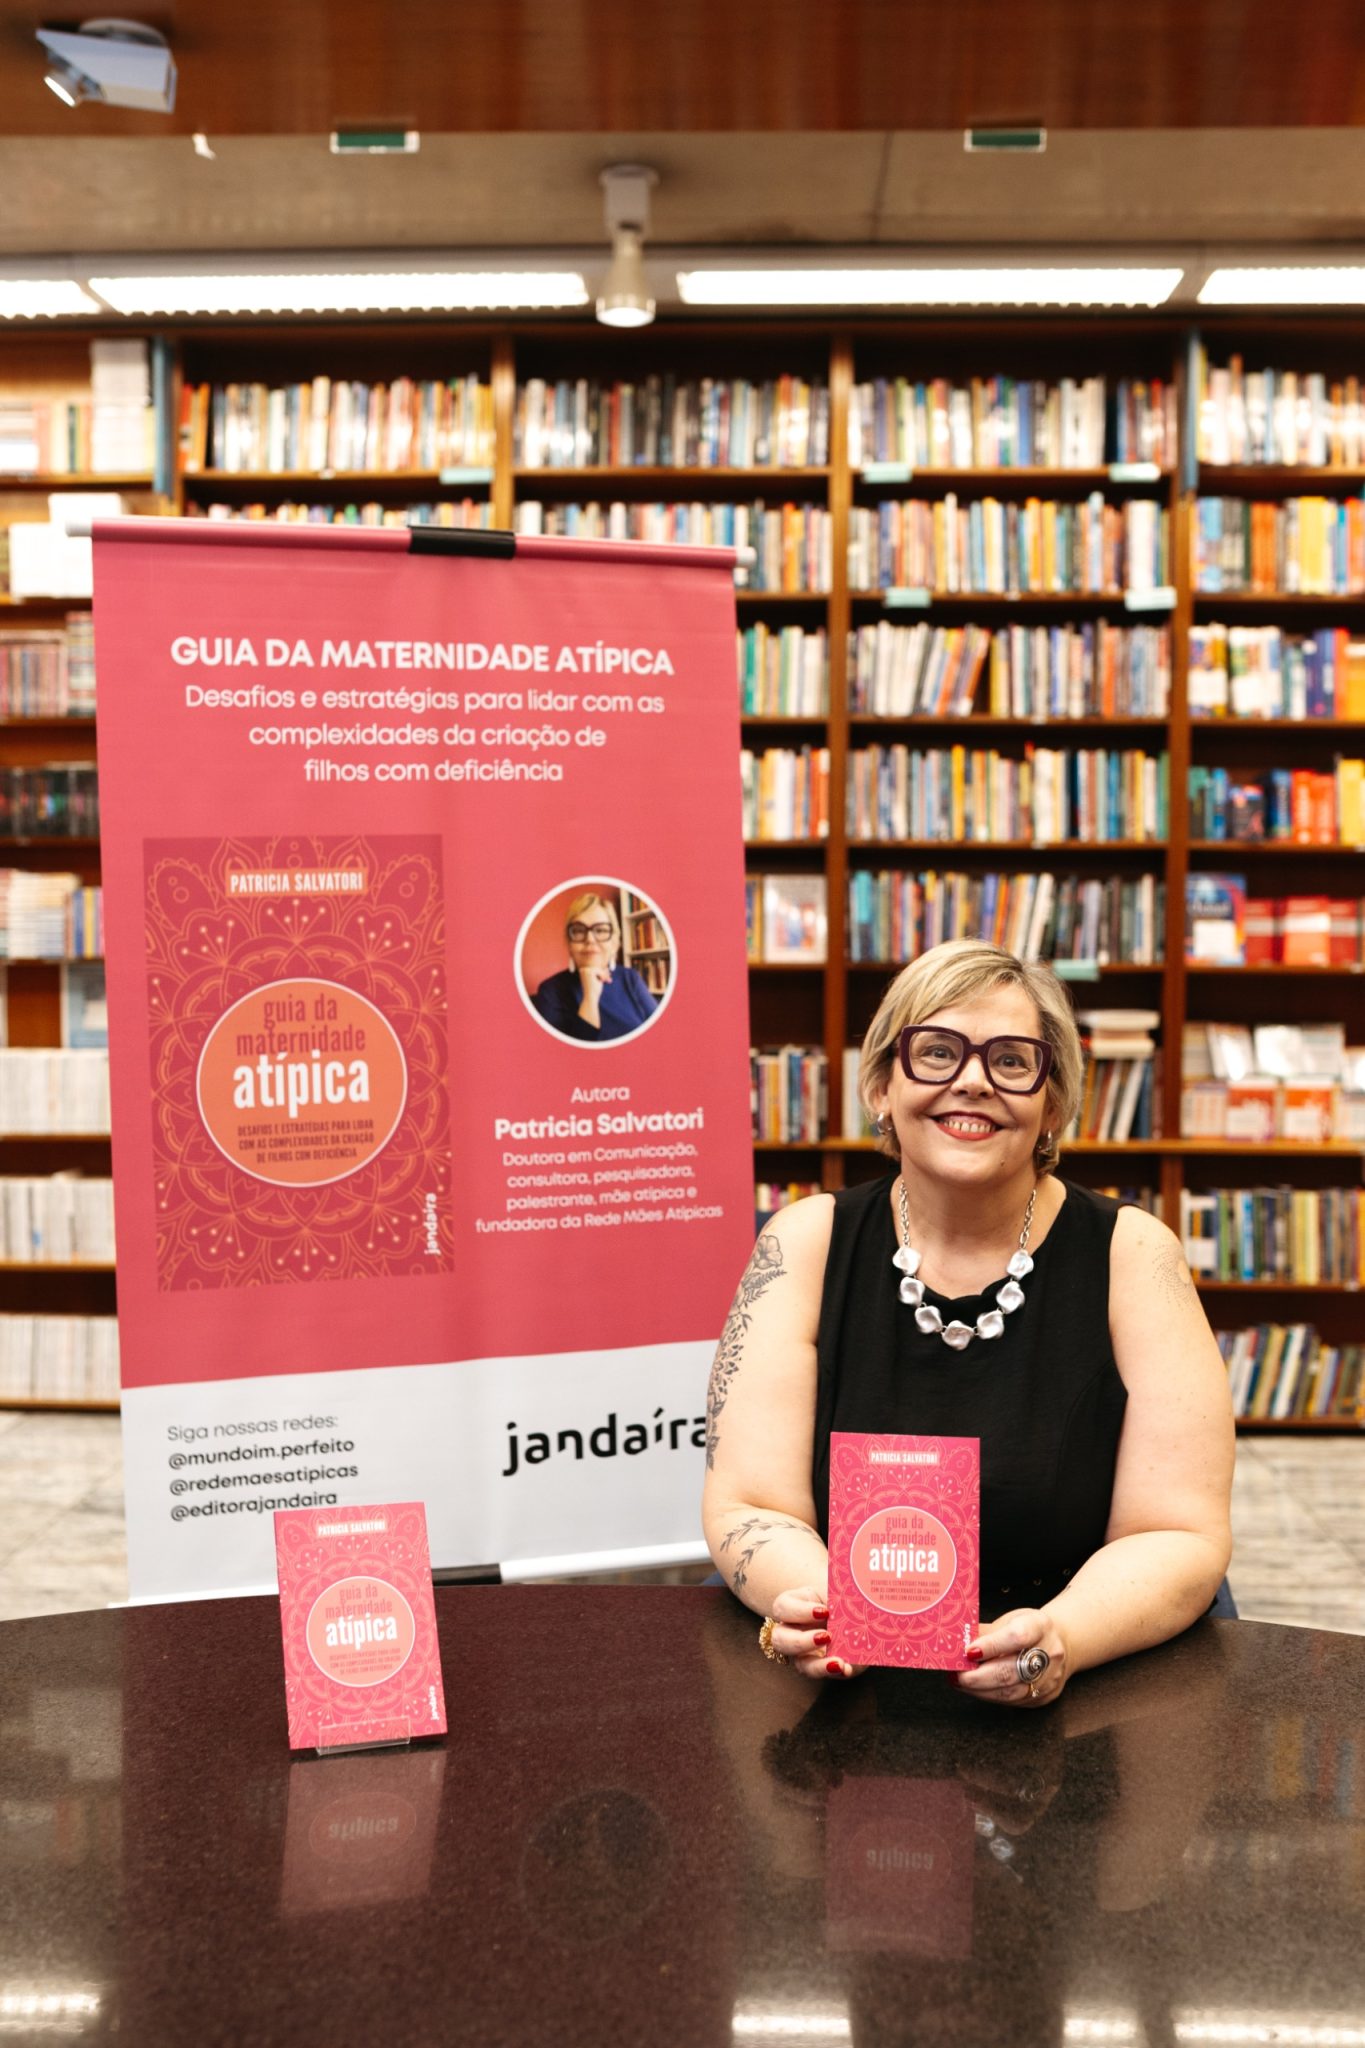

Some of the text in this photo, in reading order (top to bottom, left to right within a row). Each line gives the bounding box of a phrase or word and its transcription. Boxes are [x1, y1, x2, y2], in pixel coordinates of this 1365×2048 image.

[170, 636, 675, 675] GUIA DA MATERNIDADE ATÍPICA
[185, 684, 665, 714] Desafios e estratégias para lidar com as
[249, 722, 606, 751] complexidades da criação de
[304, 758, 563, 782] filhos com deficiência
[230, 871, 363, 893] PATRICIA SALVATORI
[264, 993, 338, 1030] guia da
[236, 1024, 366, 1056] maternidade
[233, 1049, 370, 1119] atípica
[570, 1086, 630, 1104] Autora
[494, 1107, 704, 1140] Patricia Salvatori
[502, 1142, 698, 1166] Doutora em Comunicação,
[507, 1165, 695, 1188] consultora, pesquisadora,
[599, 1188, 631, 1204] mãe
[633, 1185, 685, 1203] atípica
[687, 1186, 697, 1198] e
[475, 1204, 723, 1233] fundadora da Rede Mães Atípicas
[167, 1414, 339, 1444] Siga nossas redes:
[502, 1407, 707, 1476] jandaíra
[168, 1438, 355, 1470] @mundoim.perfeito
[169, 1465, 359, 1496] @redemaesatipicas
[170, 1492, 338, 1522] @editorajandaira
[886, 1514, 924, 1531] guia da
[870, 1530, 936, 1546] maternidade
[869, 1543, 939, 1579] atípica
[325, 1598, 393, 1620] maternidade
[339, 1584, 379, 1606] guia da
[326, 1612, 398, 1650] atípica
